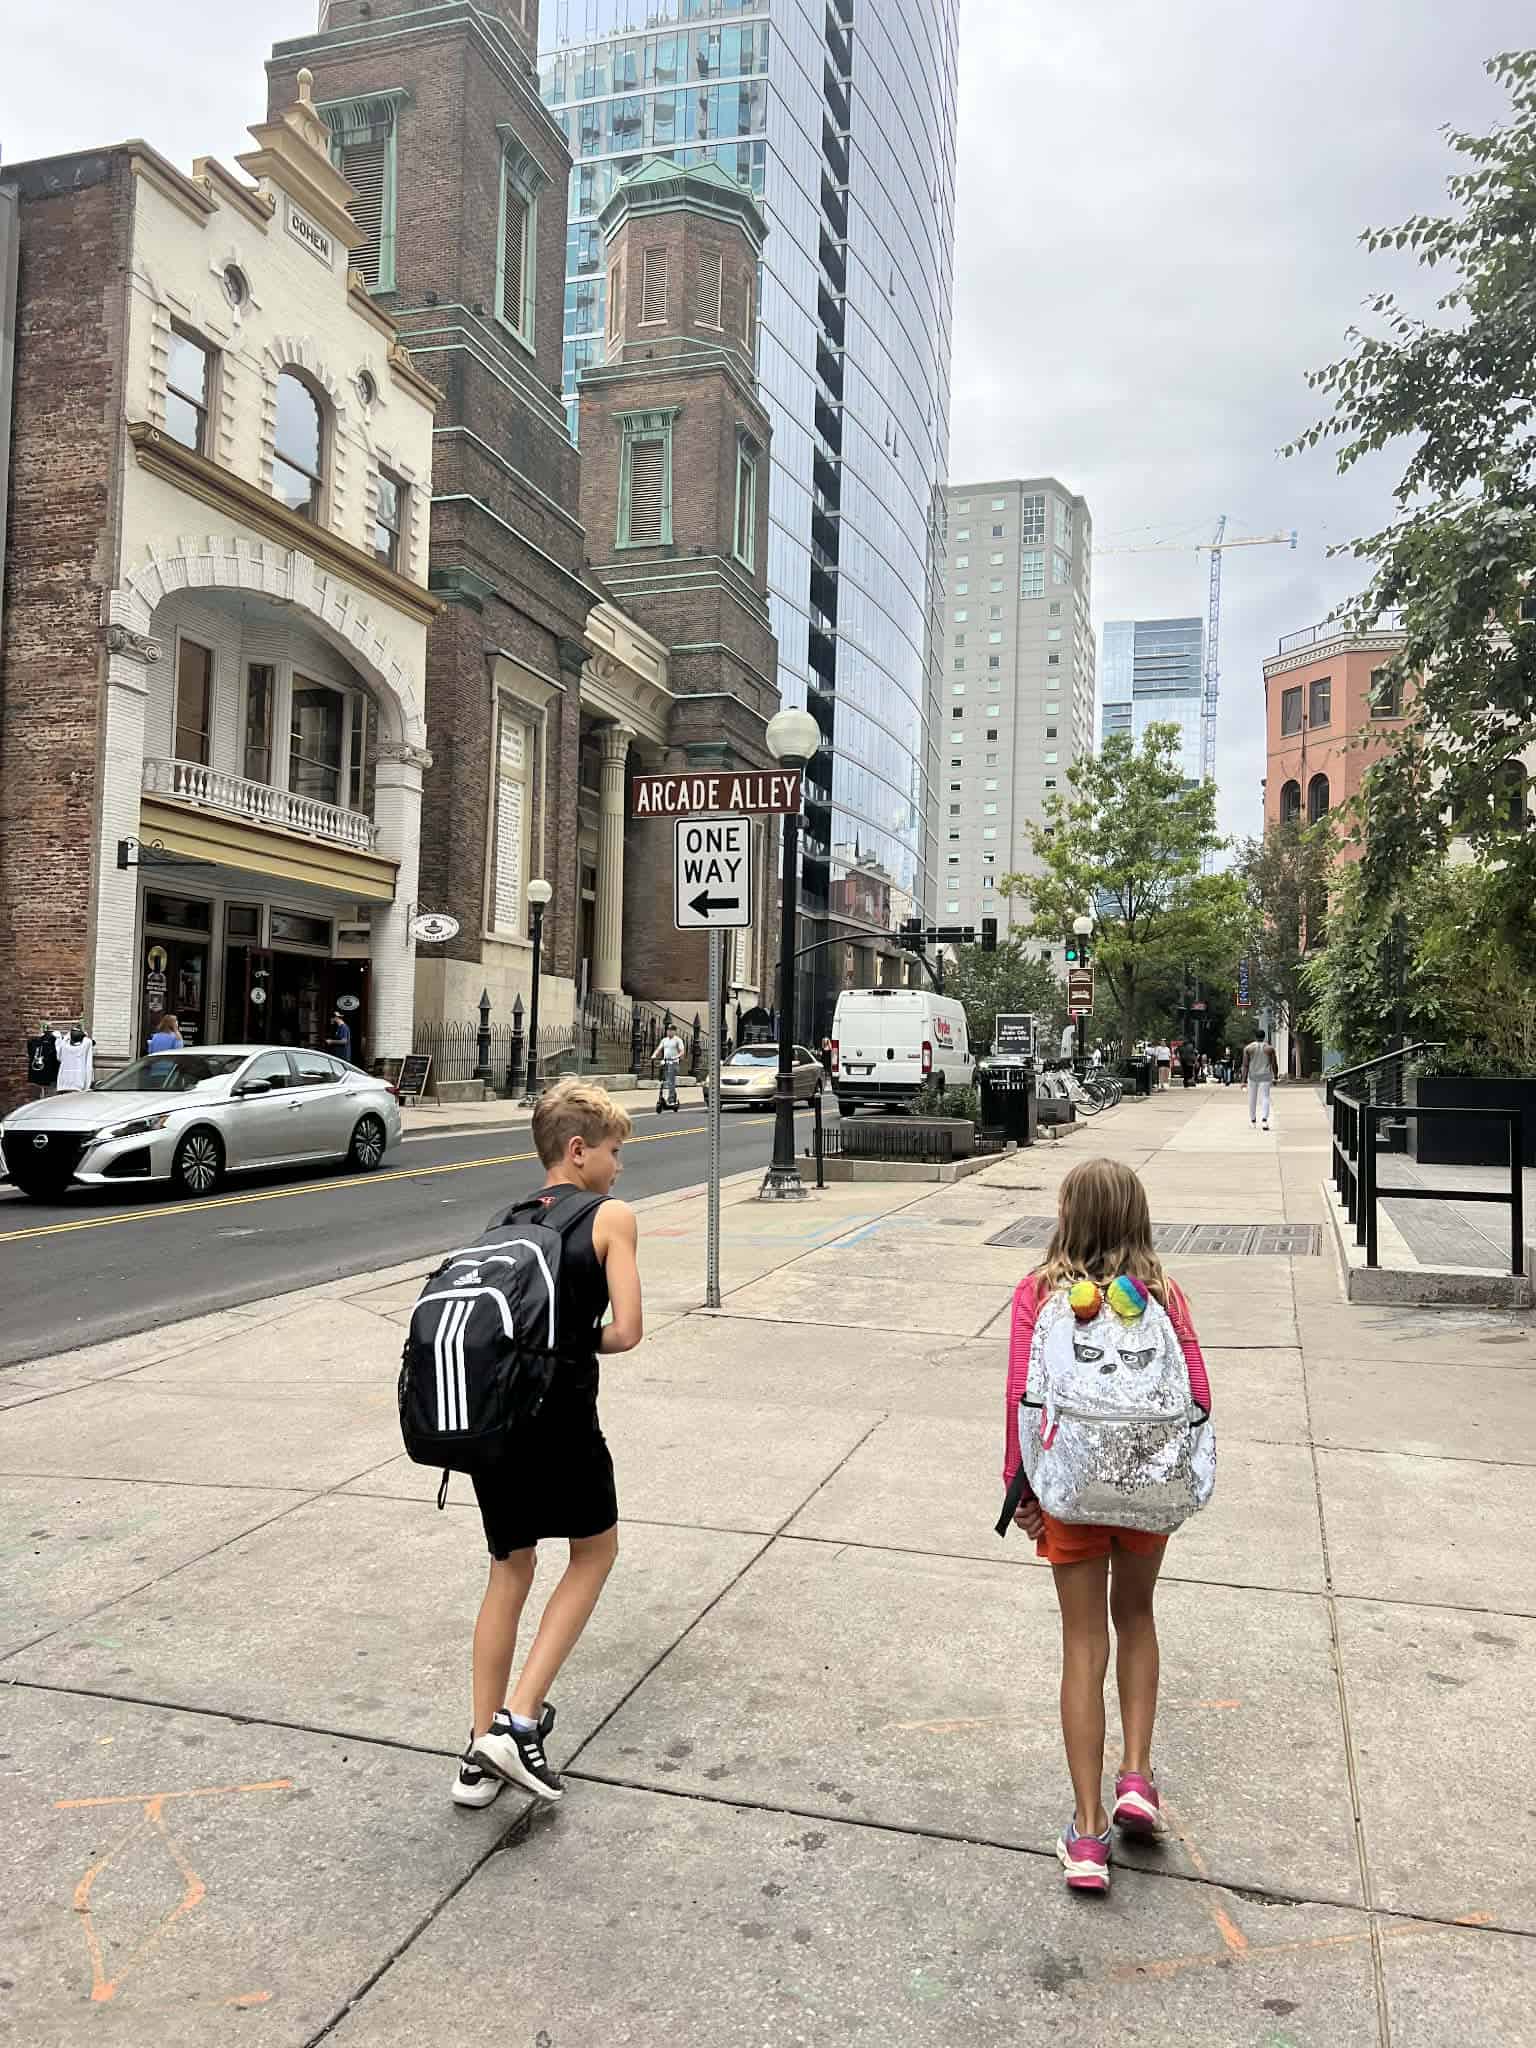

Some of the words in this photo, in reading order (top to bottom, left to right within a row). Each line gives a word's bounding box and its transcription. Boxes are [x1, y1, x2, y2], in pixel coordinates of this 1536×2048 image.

[292, 215, 329, 257] COHEN
[637, 779, 720, 813] ARCADE
[729, 776, 797, 809] ALLEY
[686, 827, 741, 854] ONE
[684, 858, 743, 884] WAY
